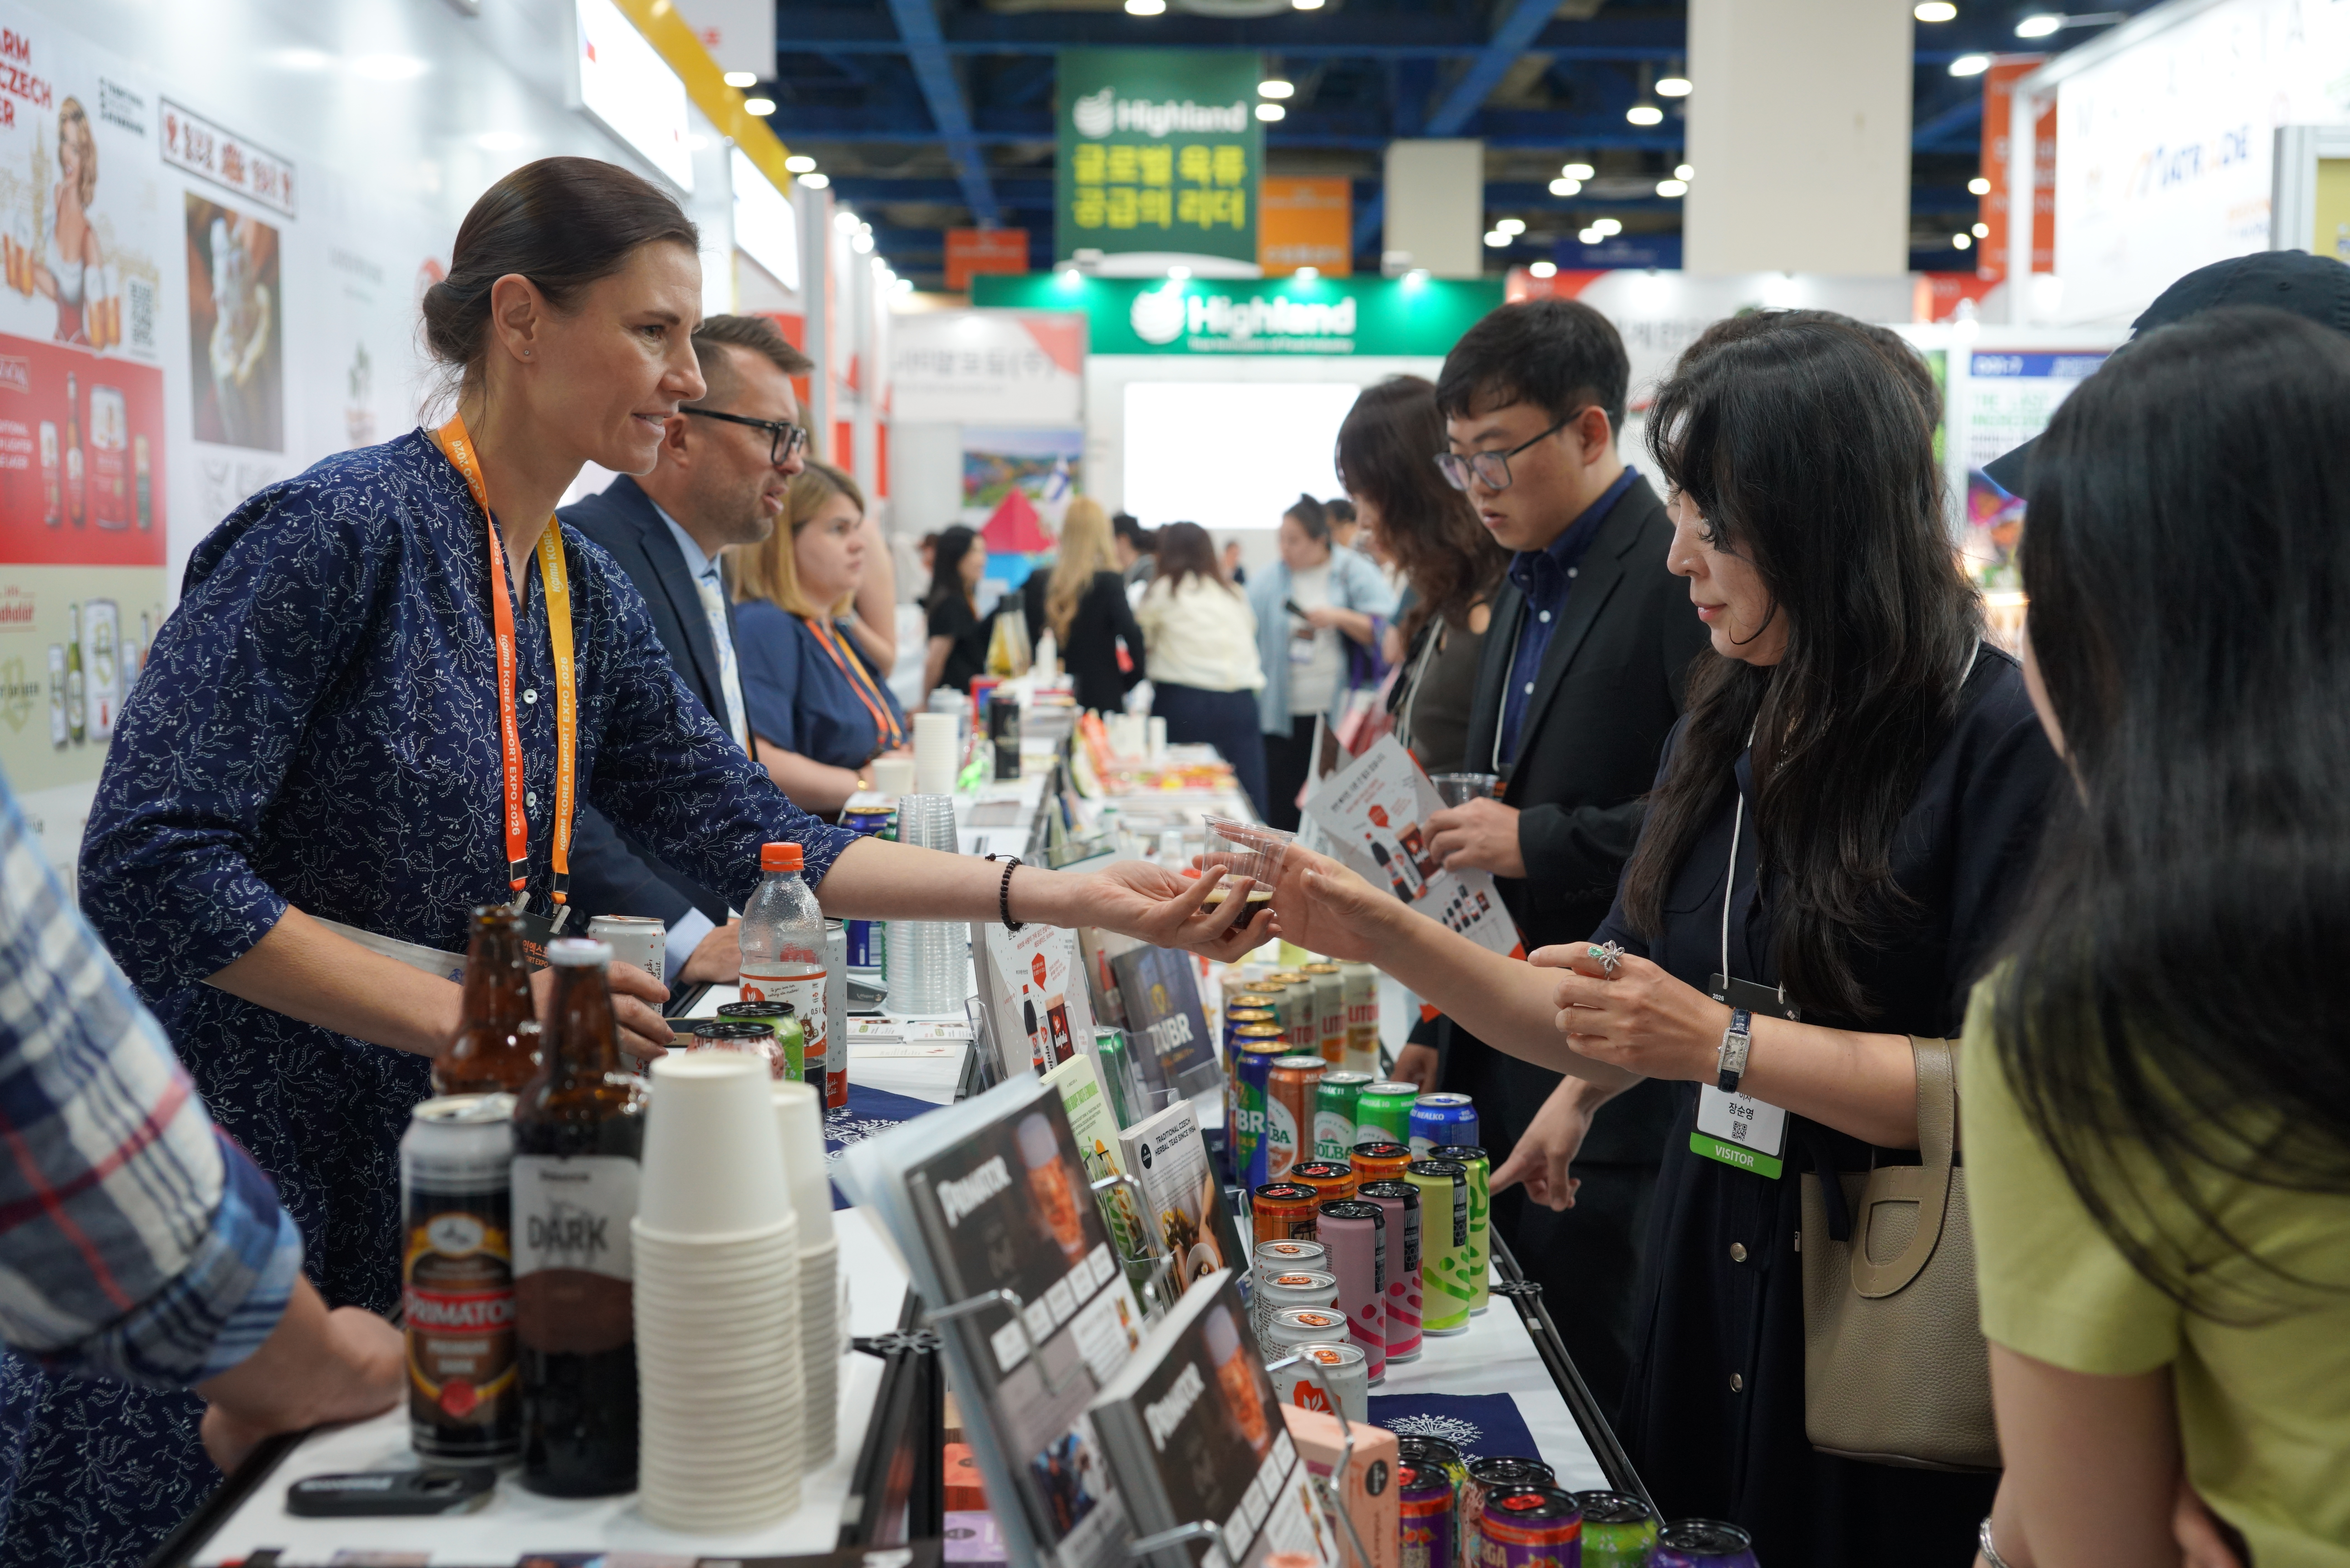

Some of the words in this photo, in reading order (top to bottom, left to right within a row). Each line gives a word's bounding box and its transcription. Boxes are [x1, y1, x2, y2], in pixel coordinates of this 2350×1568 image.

[1116, 99, 1248, 138] Highland
[1187, 295, 1356, 340] Highland
[452, 440, 468, 467] 2026
[463, 468, 483, 498] EXPO
[543, 524, 555, 560] KOREA
[561, 657, 570, 687] 2026
[505, 716, 517, 763] IMPORT
[509, 766, 517, 800] EXPO
[561, 775, 569, 815] KOREA
[511, 804, 521, 835] 2026
[535, 958, 548, 967] EXPO
[1712, 993, 1724, 1001] 2026
[1054, 1030, 1068, 1049] kofola
[1146, 1012, 1195, 1056] ZUBR
[1237, 1108, 1265, 1133] BR
[1728, 1102, 1754, 1120] 장순영
[1155, 1127, 1179, 1144] TRADITIONAL
[1179, 1117, 1191, 1131] CZECH
[1155, 1143, 1169, 1156] HERBAL
[1169, 1138, 1178, 1148] TEAS
[1178, 1131, 1189, 1141] SINCE
[1143, 1153, 1151, 1161] LEROS
[1715, 1145, 1754, 1167] VISITOR
[527, 1214, 608, 1252] DARK
